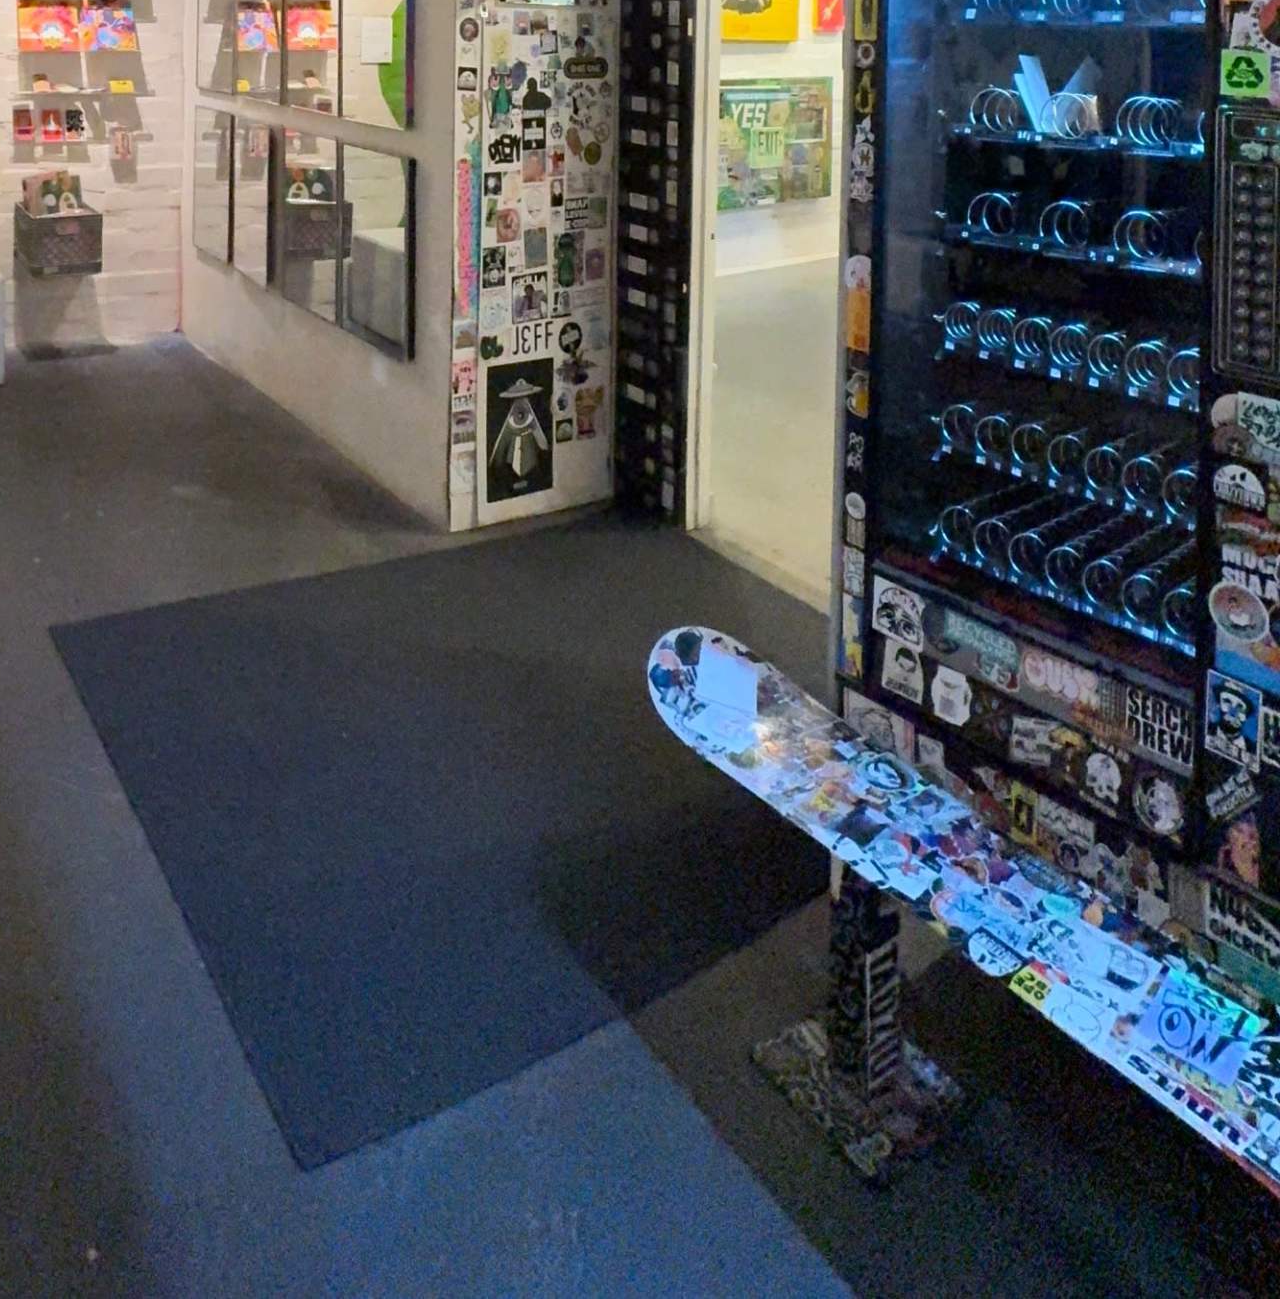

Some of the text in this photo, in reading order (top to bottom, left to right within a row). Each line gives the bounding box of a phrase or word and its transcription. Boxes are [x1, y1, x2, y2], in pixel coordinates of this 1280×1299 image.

[731, 102, 768, 128] YES
[758, 130, 780, 157] EXIT
[512, 320, 554, 356] JEFF
